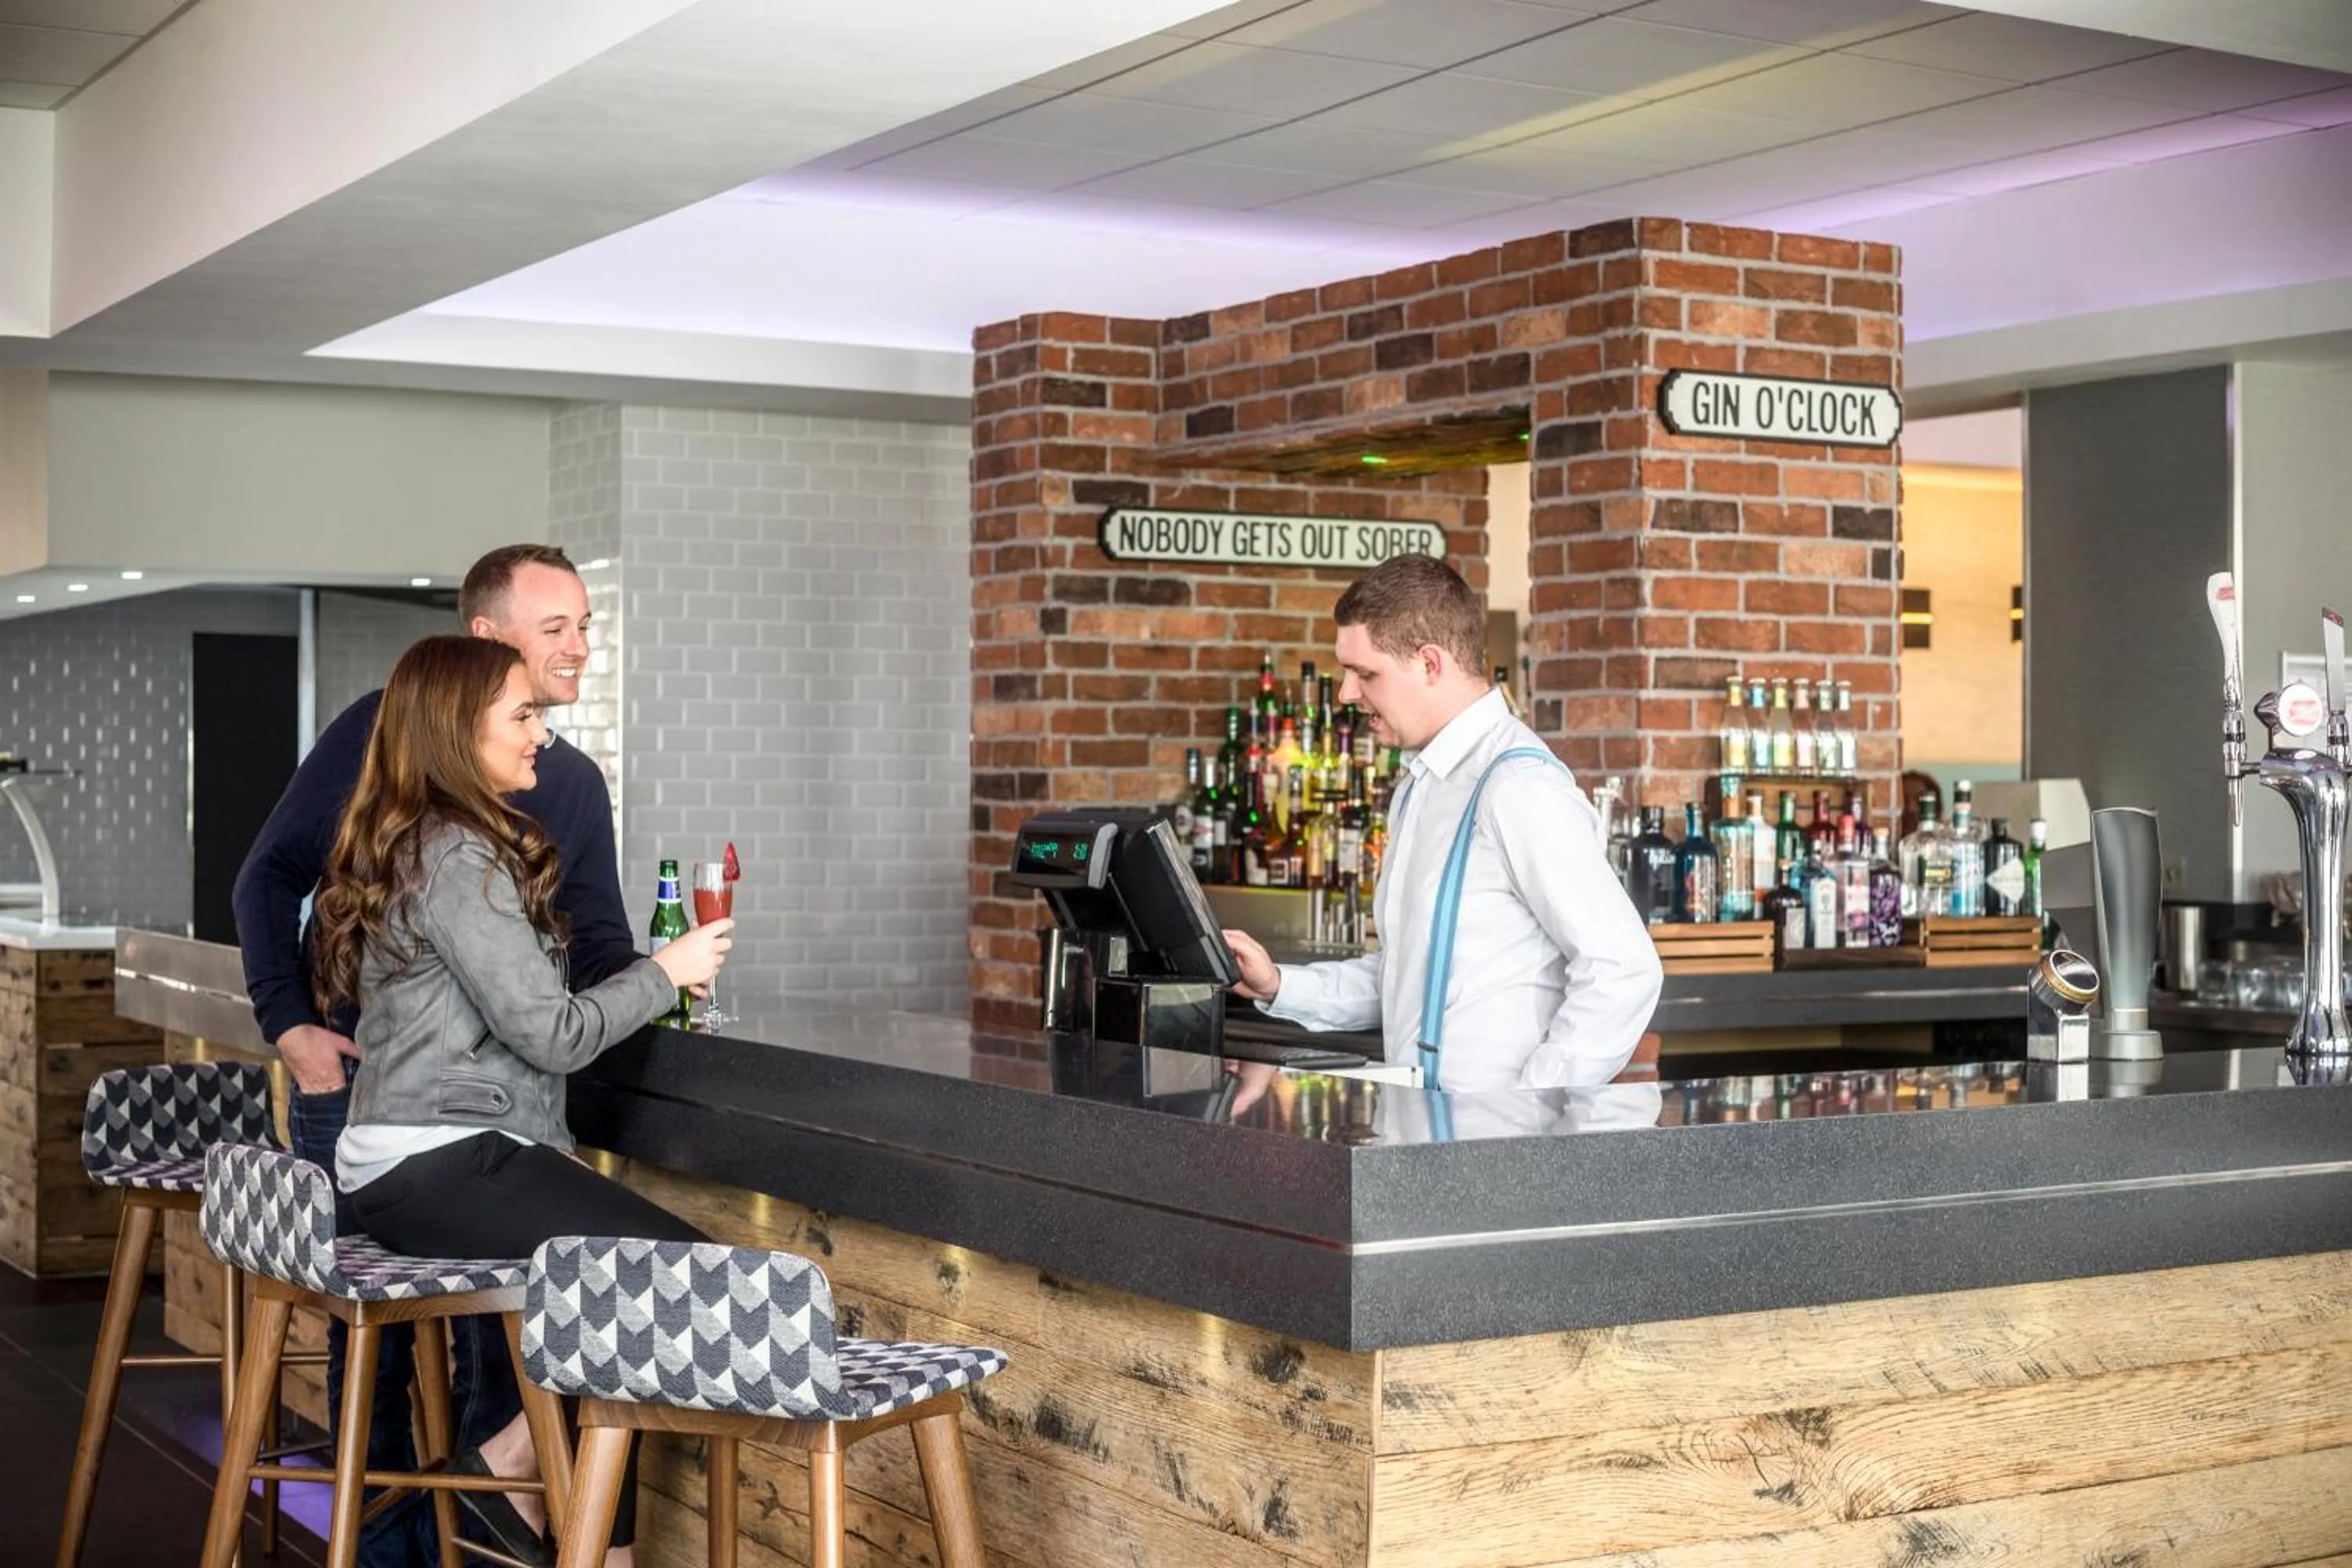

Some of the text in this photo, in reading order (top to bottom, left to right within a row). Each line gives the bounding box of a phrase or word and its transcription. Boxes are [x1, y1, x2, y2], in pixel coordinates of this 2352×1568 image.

[1692, 381, 1877, 437] GIN O'CLOCK
[1119, 516, 1433, 561] NOBODY GETS OUT SOBER
